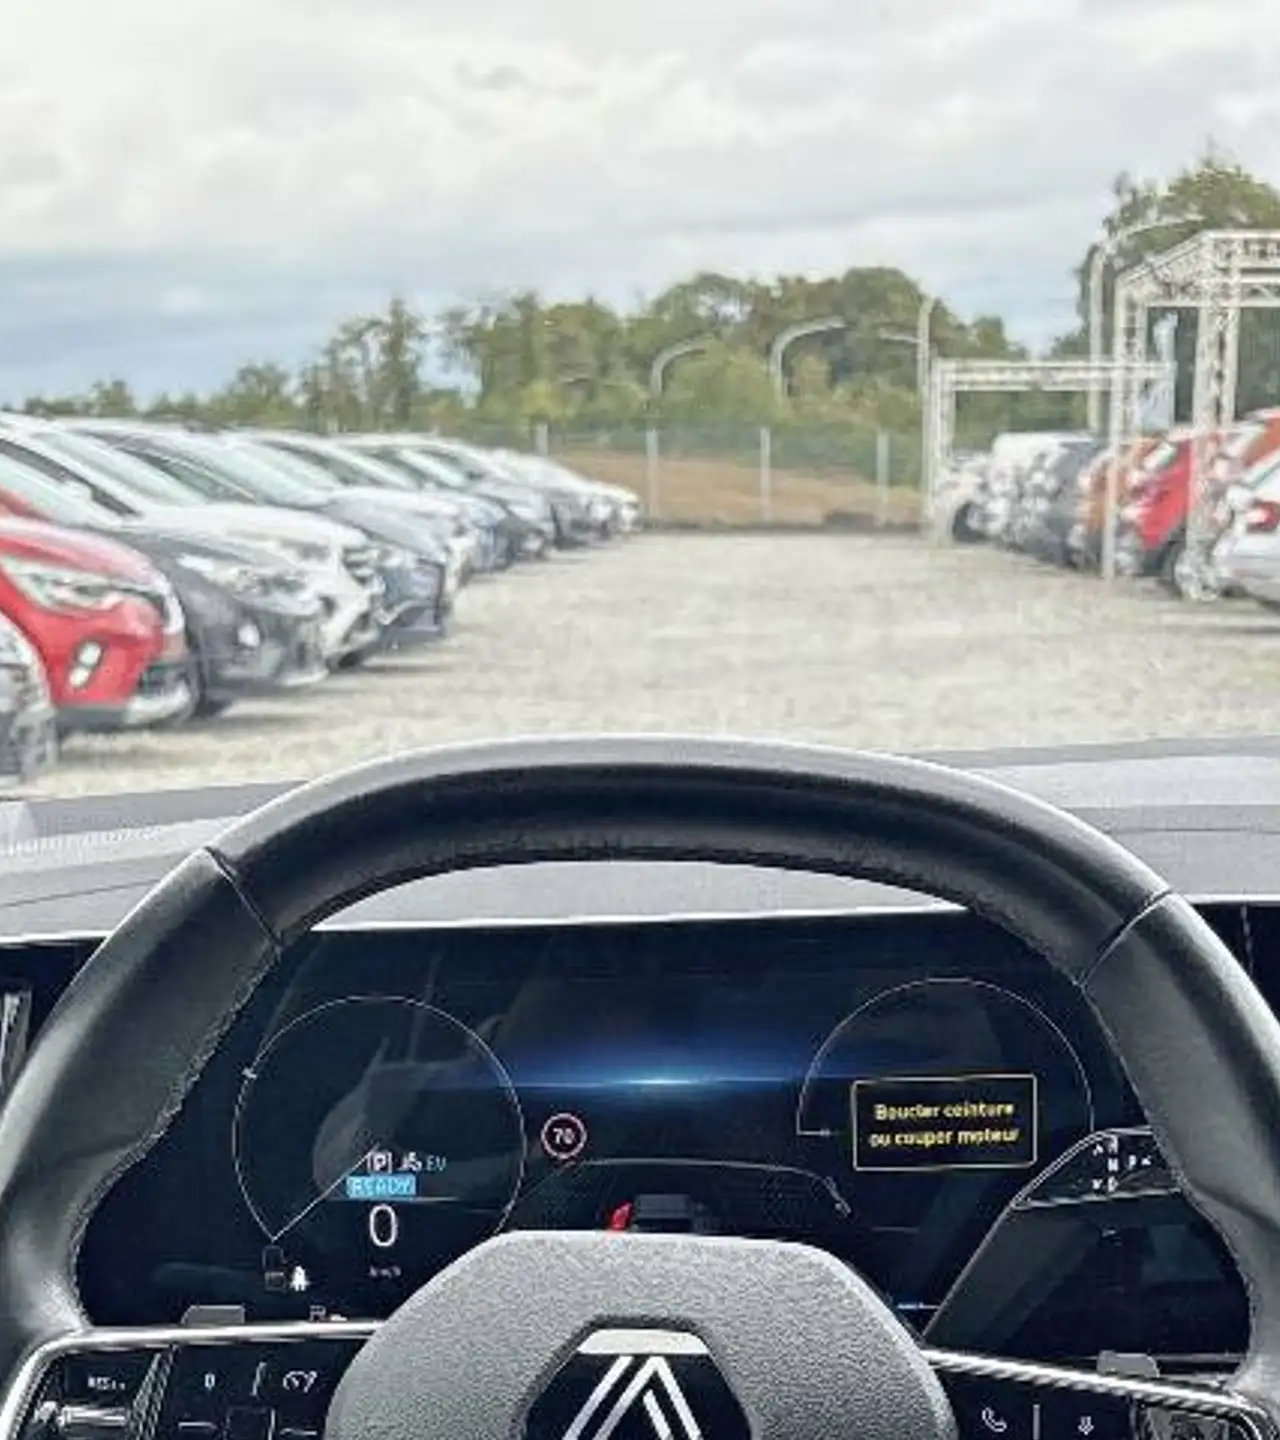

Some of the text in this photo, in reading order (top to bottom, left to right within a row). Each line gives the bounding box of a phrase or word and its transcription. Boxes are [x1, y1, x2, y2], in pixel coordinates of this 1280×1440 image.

[874, 1100, 1014, 1120] Boucler ceinture
[870, 1128, 1019, 1148] ou couper moteur
[350, 1178, 412, 1196] READY
[370, 1204, 397, 1247] 0
